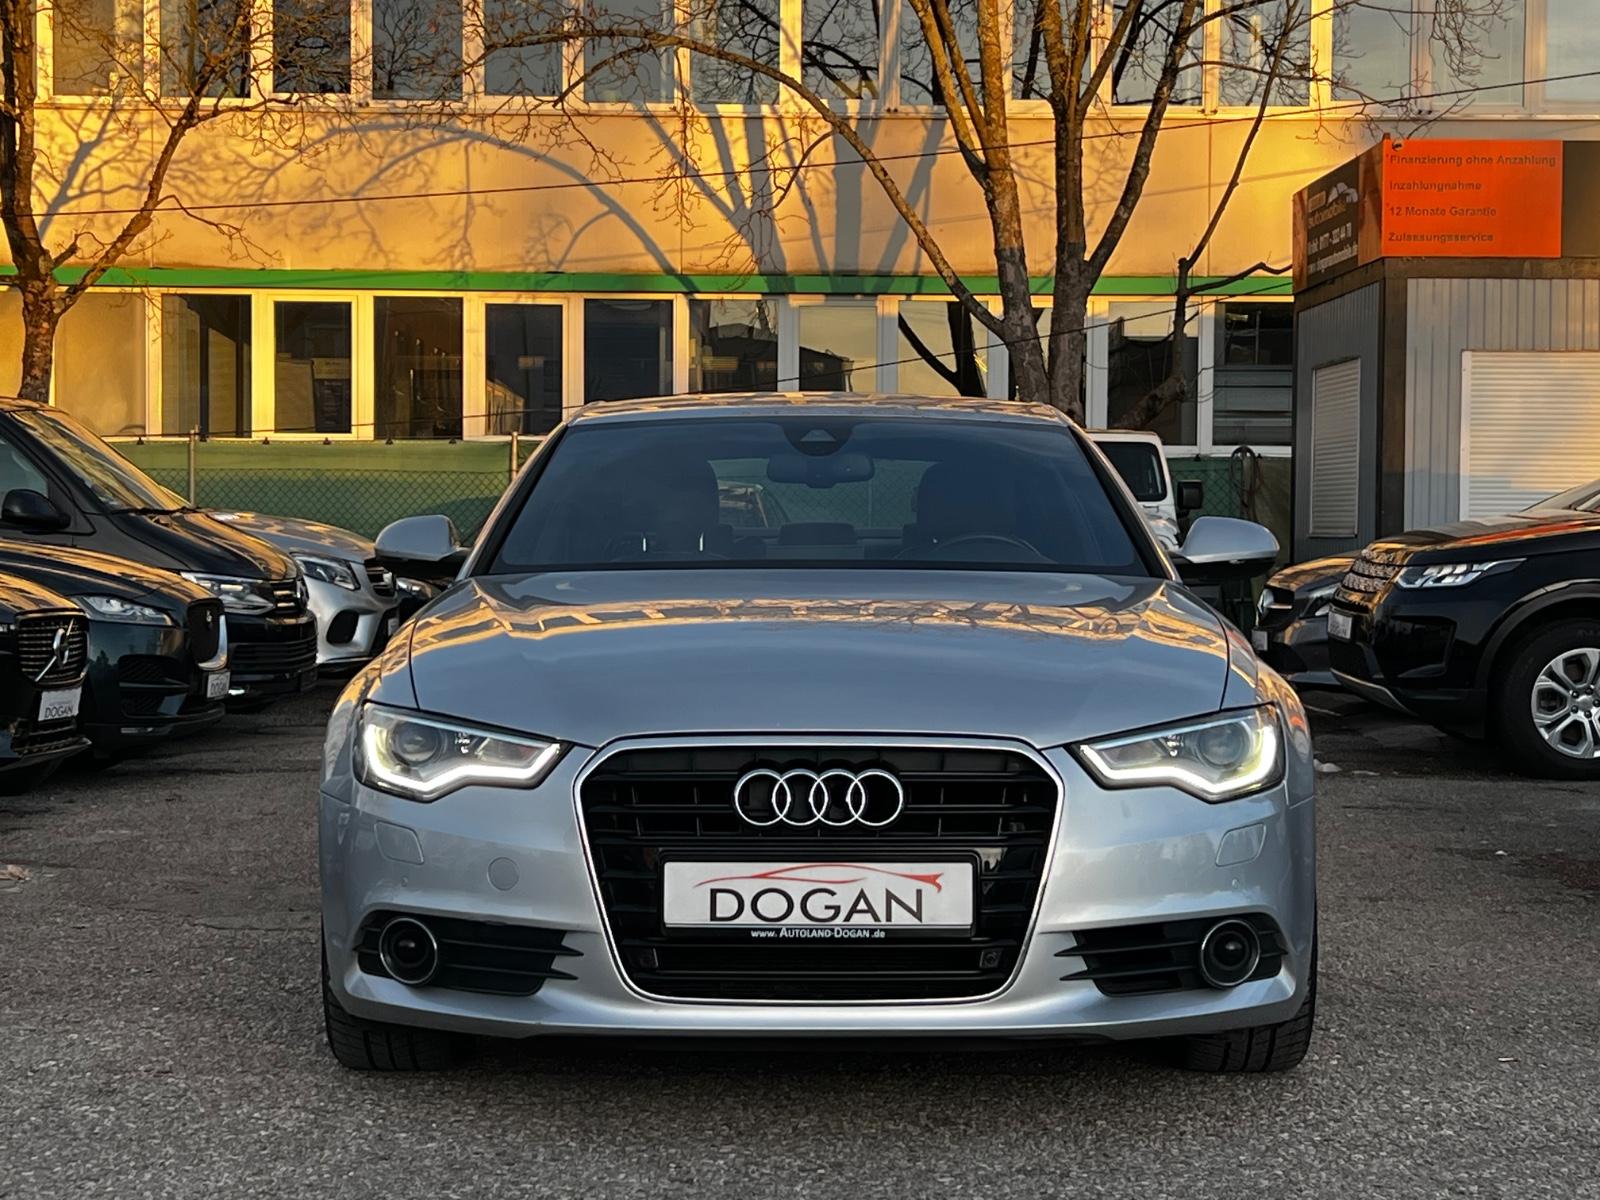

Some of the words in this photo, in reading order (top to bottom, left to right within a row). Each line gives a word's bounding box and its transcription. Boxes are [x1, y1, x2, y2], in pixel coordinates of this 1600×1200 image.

[1389, 155, 1463, 168] Finanzierung
[1466, 155, 1494, 166] ohne
[1497, 155, 1557, 168] Anzahlung
[1389, 181, 1483, 193] Inzahlungnahme
[1389, 206, 1402, 217] 12
[1405, 206, 1447, 217] Monate
[1449, 206, 1497, 217] Garantie
[1388, 232, 1495, 244] Zulassungsservice
[44, 704, 74, 719] DOGAN
[709, 887, 923, 924] DOGAN
